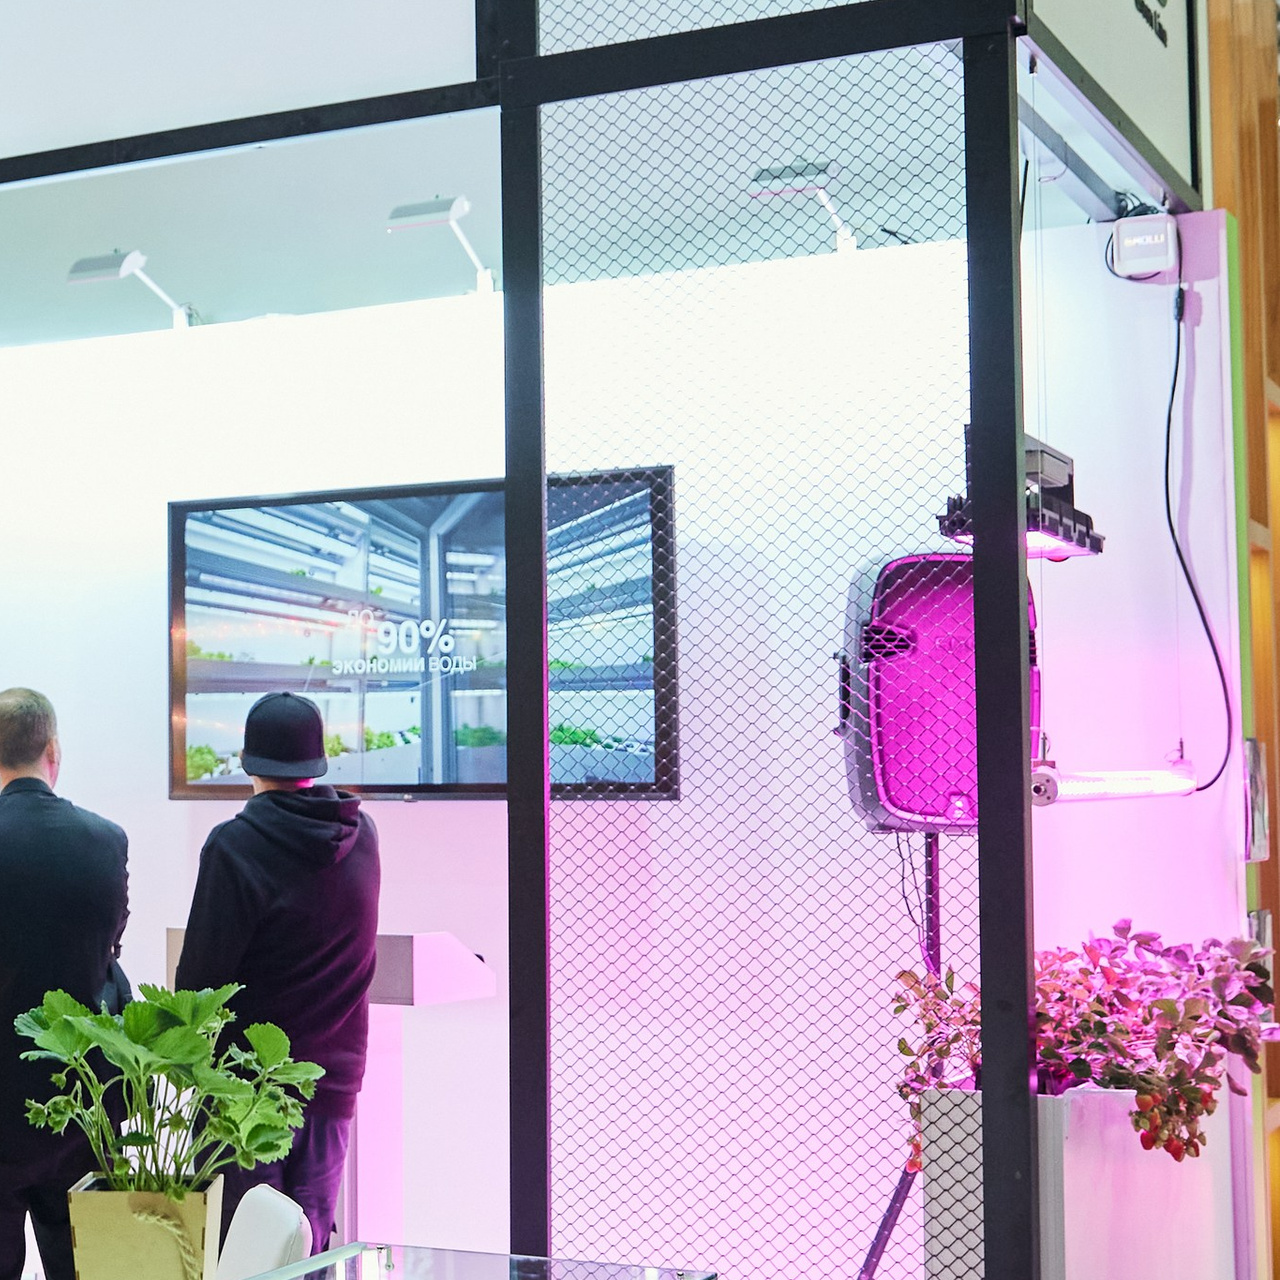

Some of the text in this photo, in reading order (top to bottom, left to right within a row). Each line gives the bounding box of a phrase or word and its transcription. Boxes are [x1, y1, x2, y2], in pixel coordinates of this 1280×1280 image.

[377, 618, 455, 655] 90%
[332, 655, 477, 675] ЭКОНОМИИ ВОДЫ
